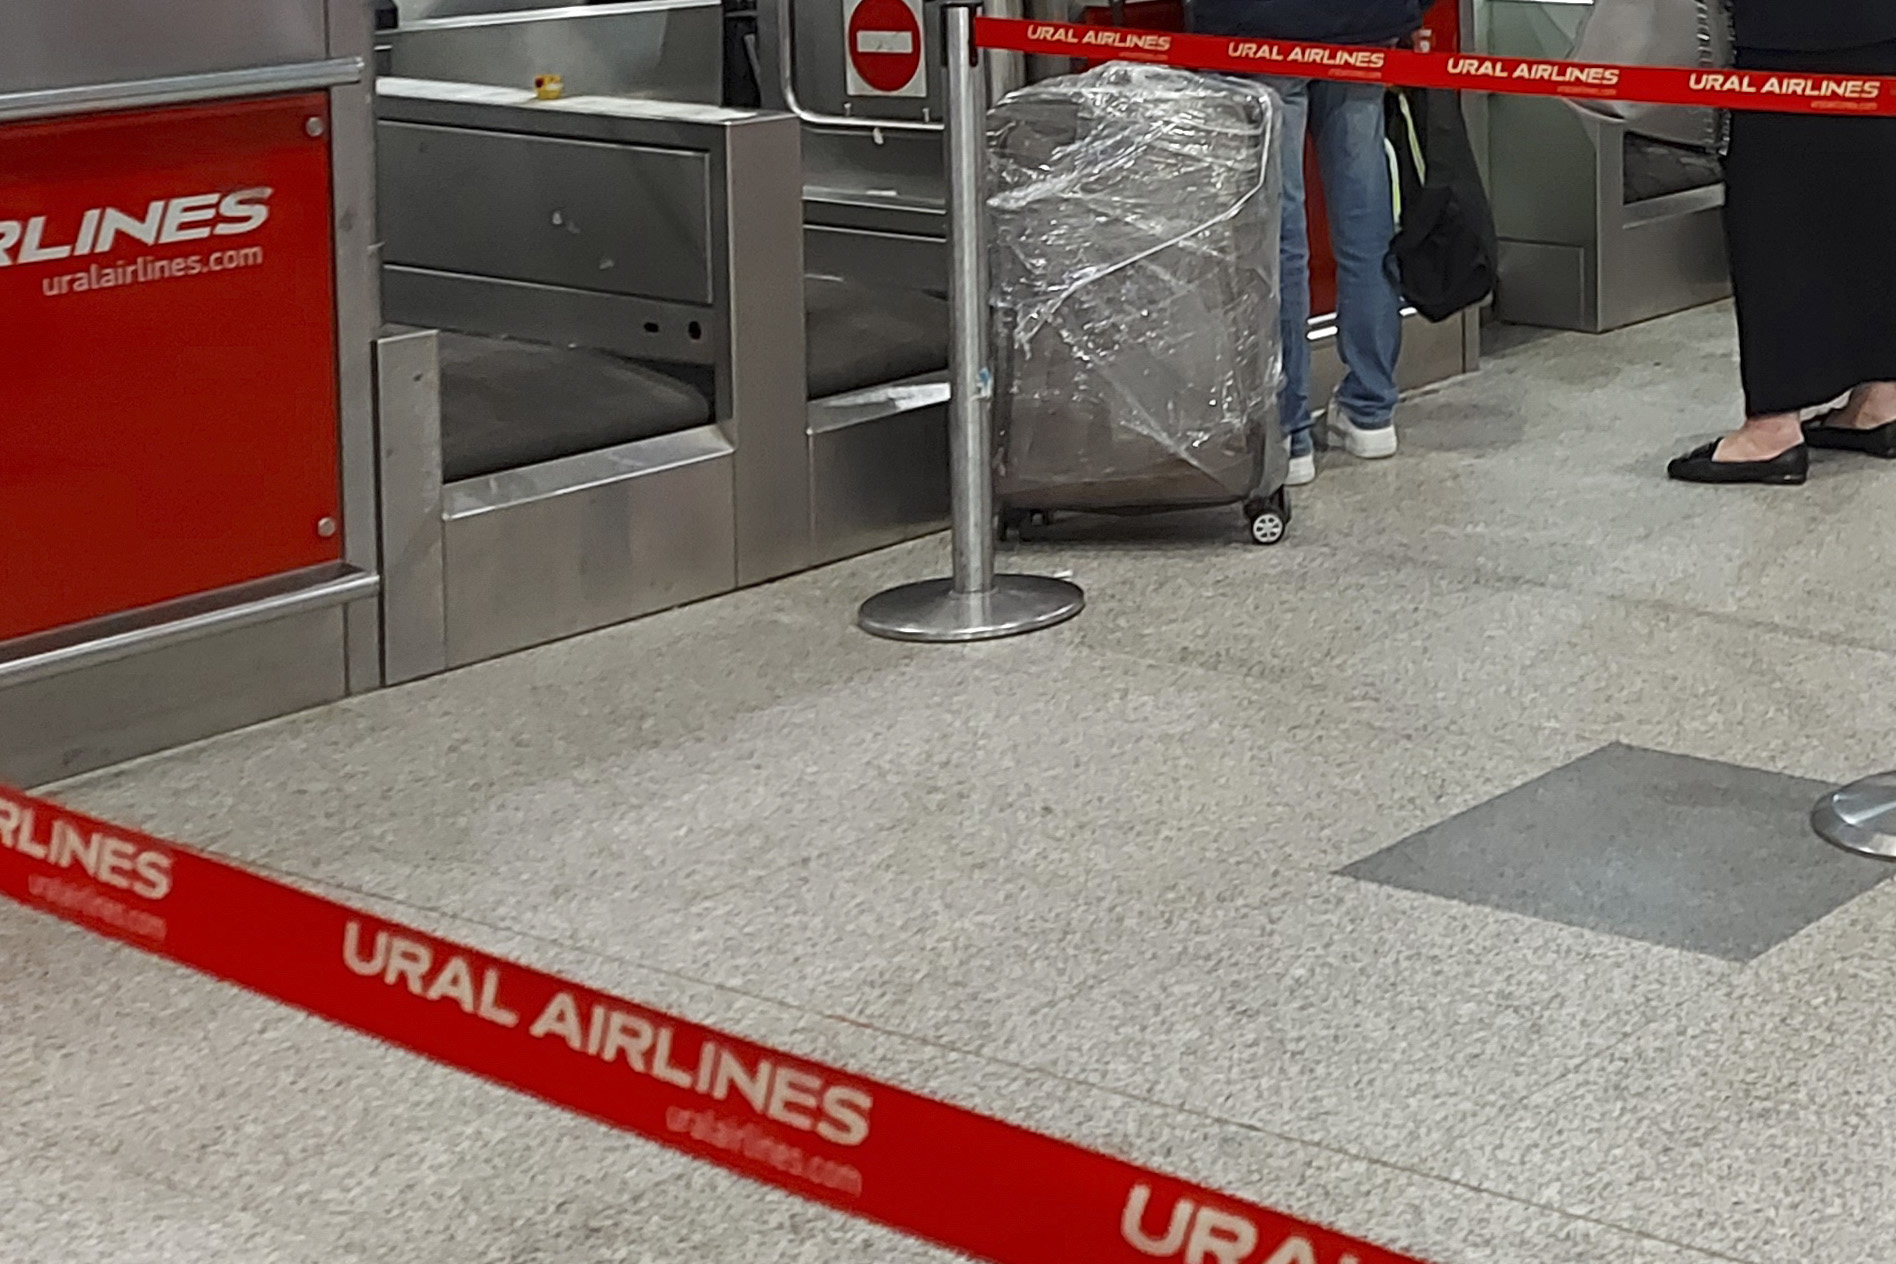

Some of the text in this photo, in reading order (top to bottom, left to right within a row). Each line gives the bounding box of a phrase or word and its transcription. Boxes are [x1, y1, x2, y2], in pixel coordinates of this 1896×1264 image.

[1027, 24, 1172, 51] URAL AIRLINES
[1228, 41, 1385, 68] URAL AIRLINES
[1447, 57, 1620, 85] URAL AIRLINES
[1689, 73, 1881, 98] URAL AIRLINES
[42, 245, 264, 297] uralairlines.com
[343, 922, 874, 1146] URAL AIRLINES
[1121, 1183, 1360, 1264] UR
